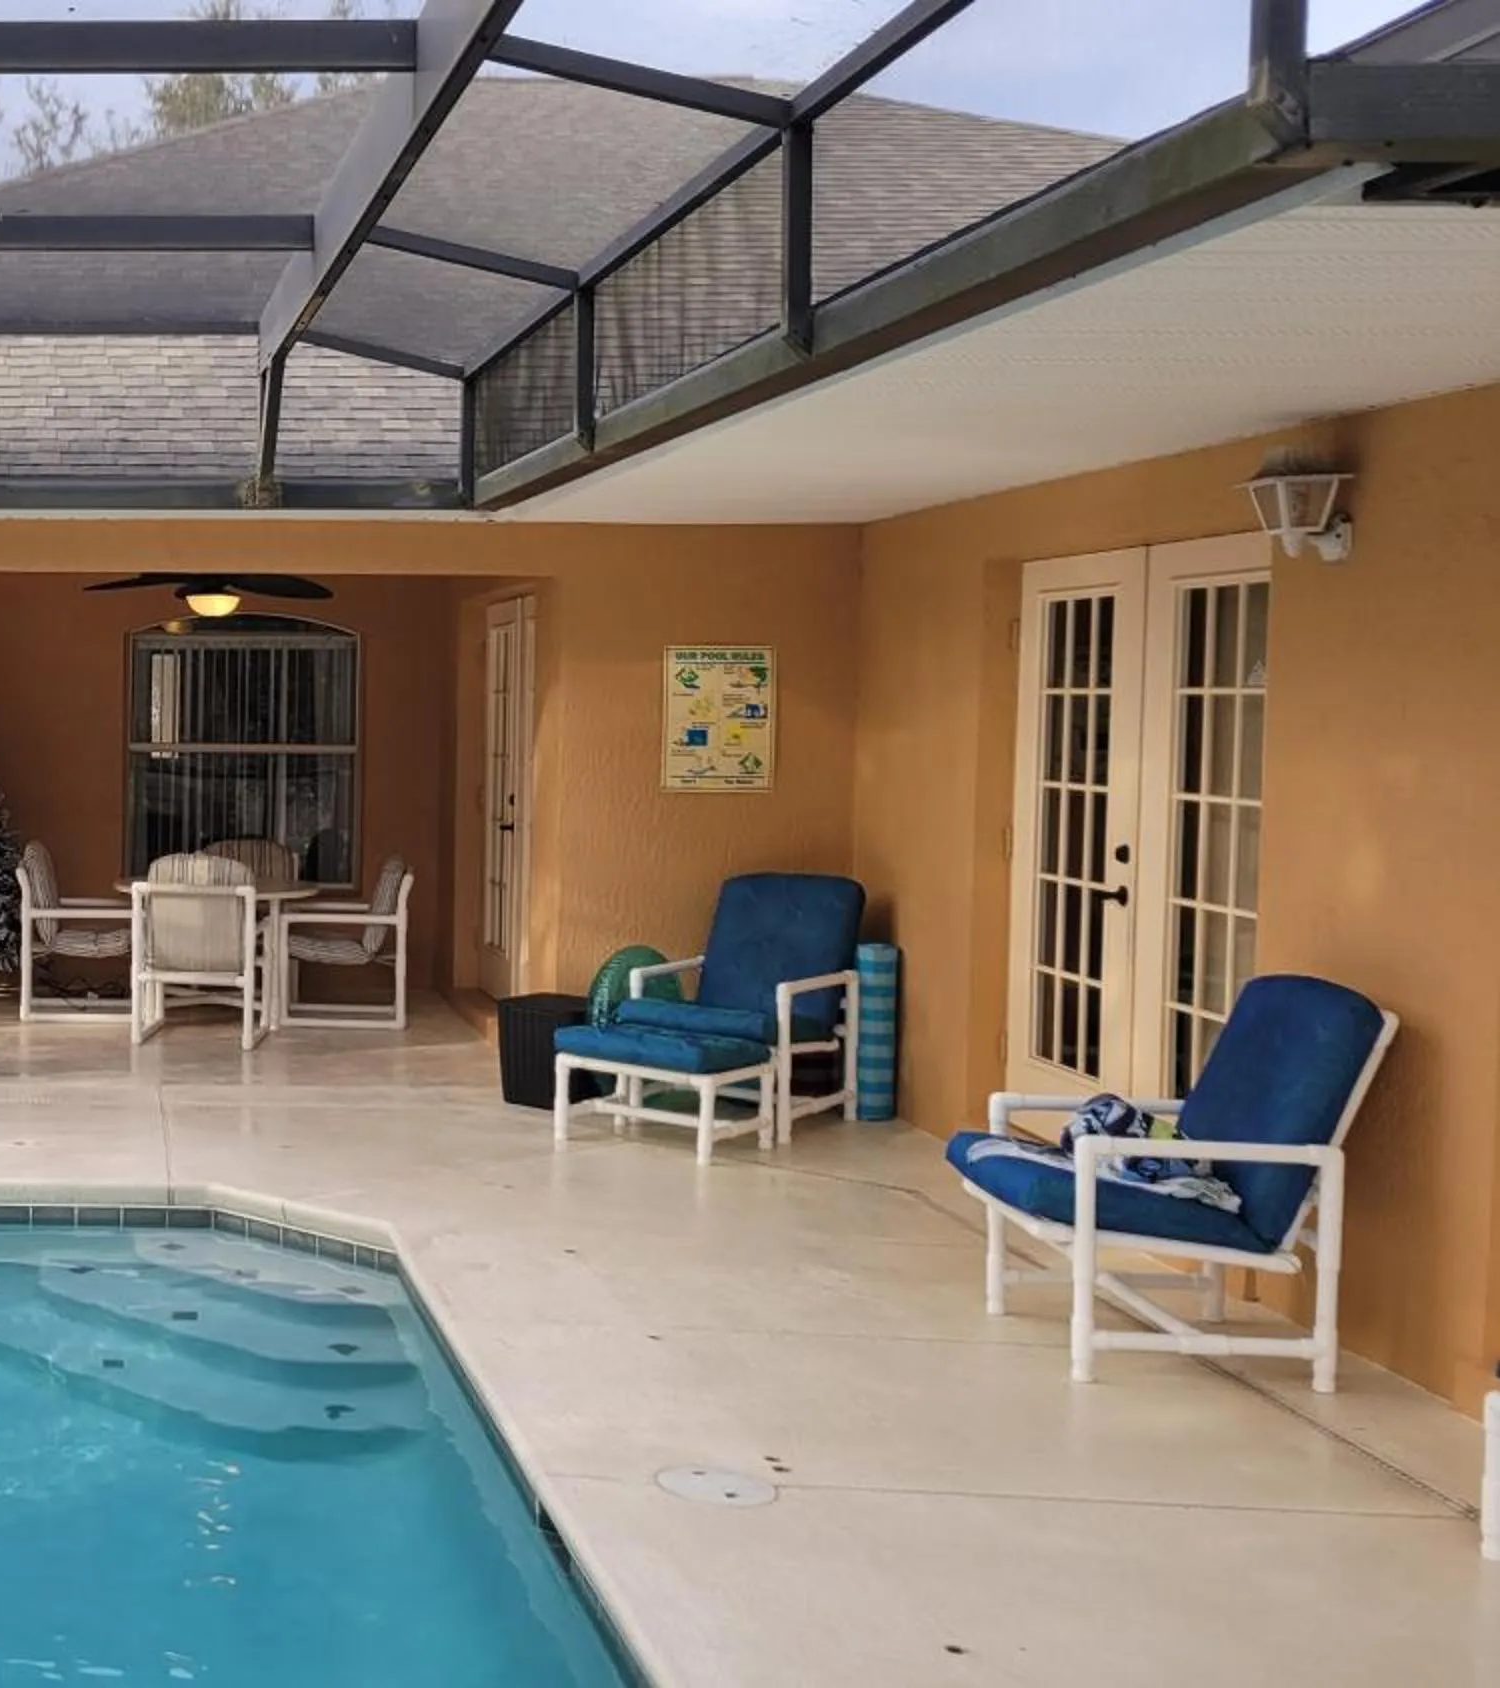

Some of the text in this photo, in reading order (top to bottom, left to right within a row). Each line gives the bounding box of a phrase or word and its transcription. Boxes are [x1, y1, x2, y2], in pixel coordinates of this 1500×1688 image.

[675, 652, 765, 661] OUR POOL RULES
